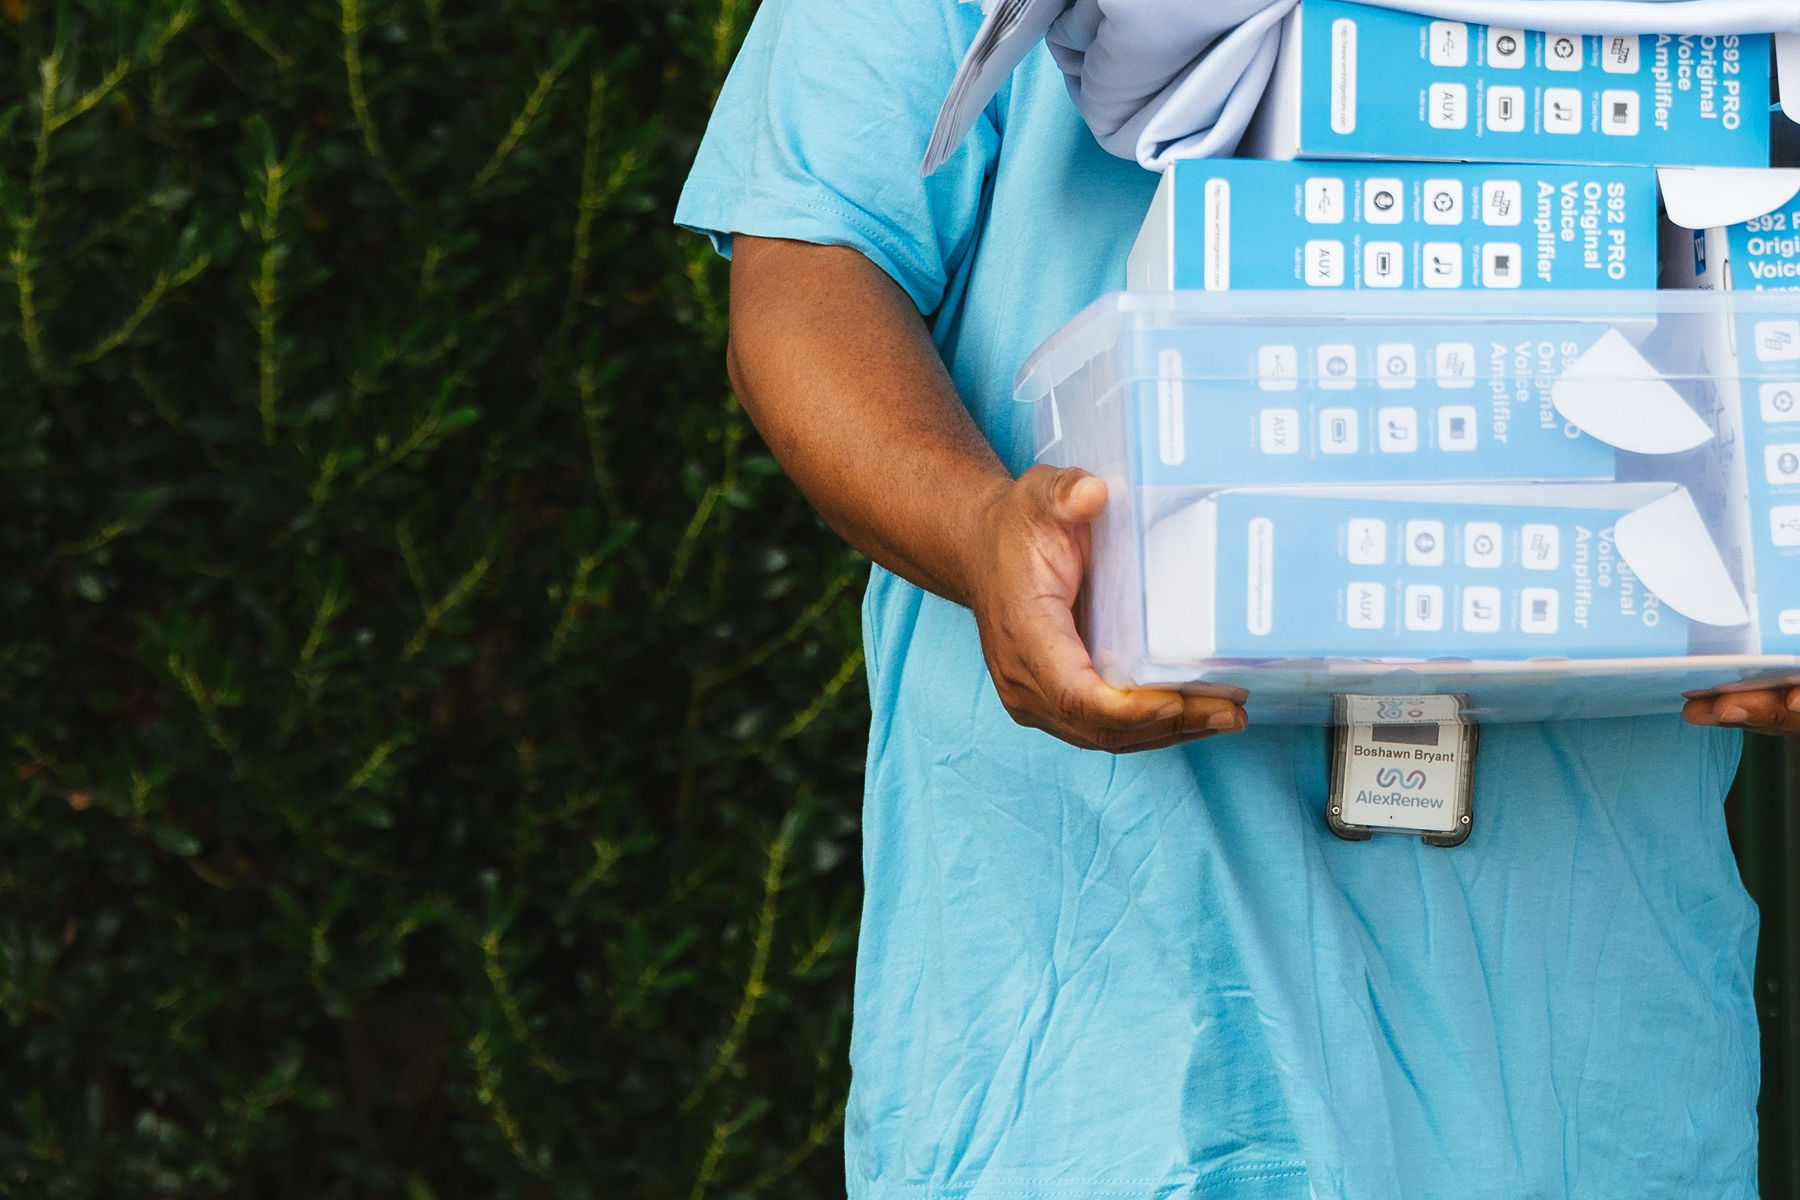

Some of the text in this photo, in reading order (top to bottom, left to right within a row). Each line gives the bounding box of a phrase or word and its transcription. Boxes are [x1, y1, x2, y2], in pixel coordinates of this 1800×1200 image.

[1652, 34, 1672, 131] Amplifier
[1678, 35, 1695, 91] Voice
[1697, 35, 1718, 119] Original
[1723, 35, 1740, 130] S92 PRO
[1442, 92, 1455, 121] AUX
[1533, 181, 1555, 283] Amplifier
[1561, 180, 1579, 242] Voice
[1580, 182, 1602, 269] Original
[1607, 182, 1626, 280] S92 PRO
[1746, 213, 1786, 233] S92
[1318, 249, 1331, 278] AUX
[1489, 341, 1511, 444] Amplifier
[1515, 341, 1531, 402] Voice
[1535, 342, 1558, 429] Original
[1271, 416, 1287, 447] AUX
[1571, 525, 1593, 628] Amplifier
[1598, 526, 1615, 588] Voice
[1358, 590, 1372, 622] AUX
[1616, 561, 1638, 616] ginal
[1642, 593, 1661, 628] RO
[1354, 745, 1455, 764] Boshawn Bryant
[1355, 790, 1444, 809] AlexRenew
